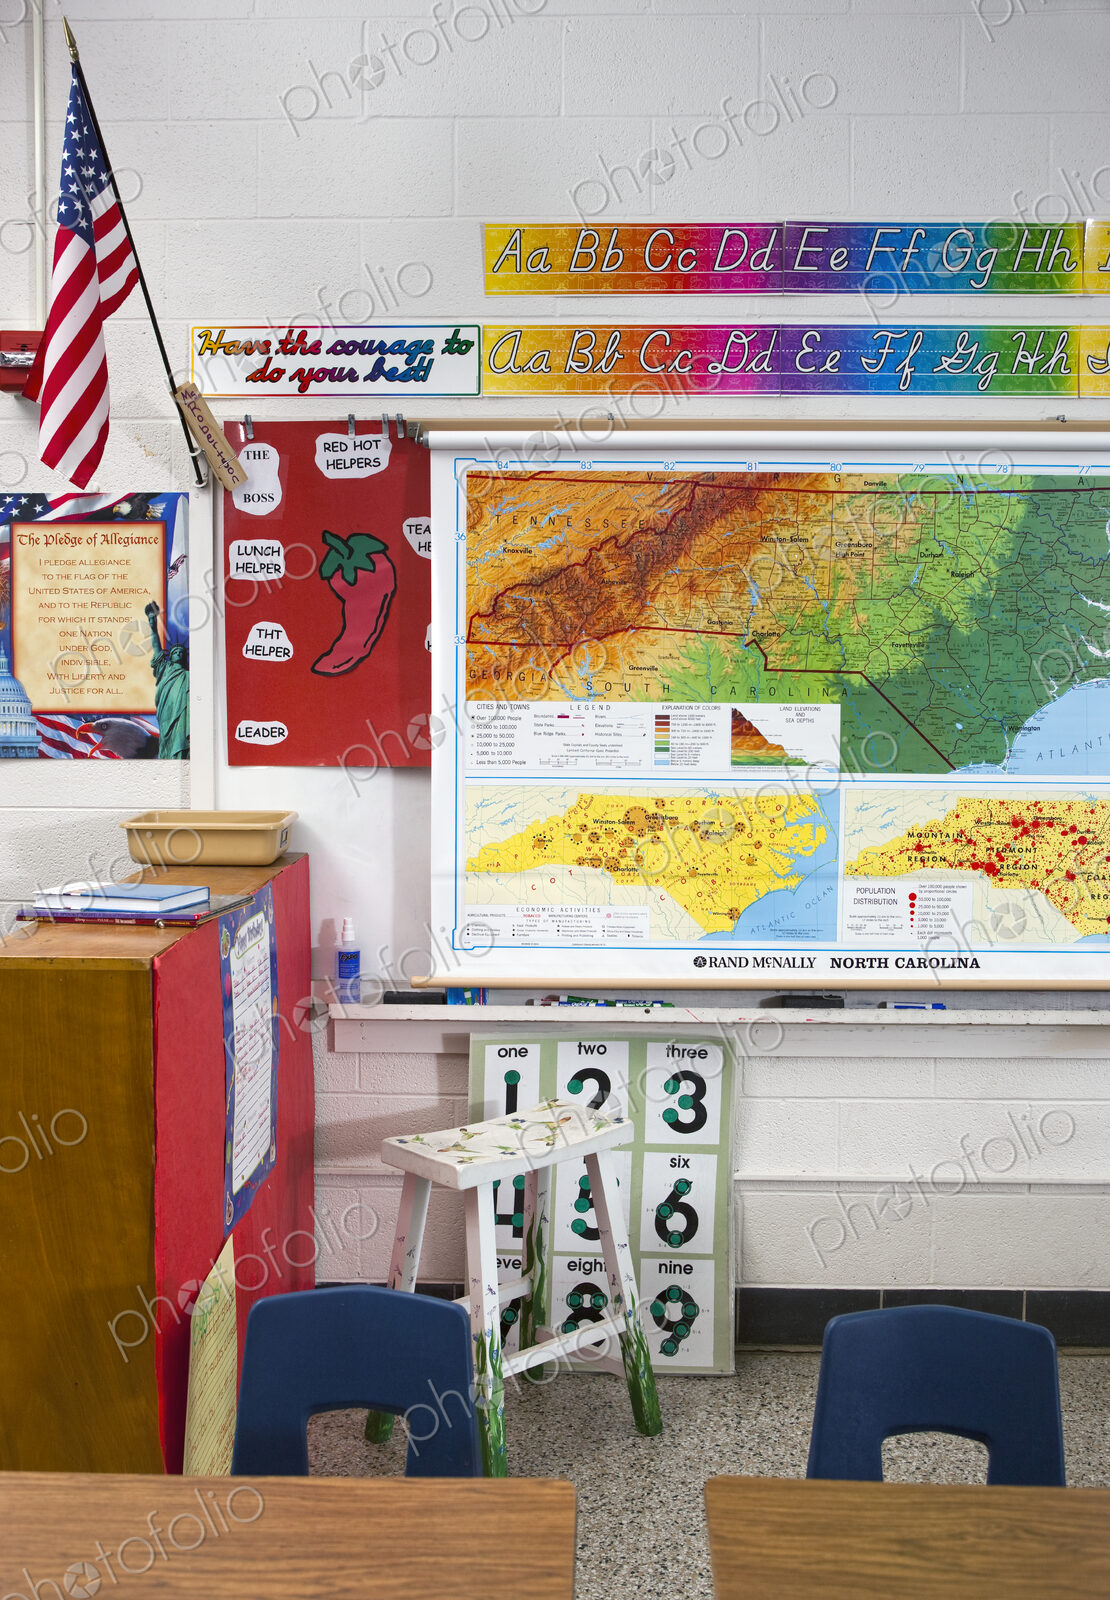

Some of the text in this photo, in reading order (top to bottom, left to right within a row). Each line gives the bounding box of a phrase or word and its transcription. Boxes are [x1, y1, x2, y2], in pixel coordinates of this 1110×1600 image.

[198, 328, 475, 366] Have the courage to
[246, 356, 435, 393] do your best!
[323, 439, 381, 453] RED HOT
[244, 450, 270, 460] THE
[326, 457, 381, 470] HELPERS
[497, 461, 509, 470] 84
[580, 461, 592, 470] 83
[664, 462, 676, 471] 82
[747, 462, 758, 471] 81
[830, 463, 842, 472] 80
[913, 464, 925, 472] 79
[997, 464, 1008, 473] 78
[1079, 466, 1091, 474] 77
[243, 493, 275, 503] BOSS
[495, 515, 645, 529] TENNESSEE
[16, 532, 160, 548] The Pledge of Allegiance
[455, 533, 466, 541] 36
[237, 545, 280, 557] LUNCH
[919, 551, 943, 559] Durham
[44, 558, 77, 566] PLEDGE
[78, 558, 131, 566] ALLEGIANCE
[236, 562, 282, 574] HELPER
[951, 571, 974, 580] Raleigh
[96, 587, 108, 595] OF
[38, 601, 57, 609] AND
[58, 601, 70, 609] TO
[72, 601, 88, 609] THE
[38, 616, 56, 624] FOR
[57, 616, 86, 624] WHICH
[88, 616, 96, 624] IT
[256, 628, 283, 640] THT
[752, 630, 780, 638] Charlotte
[454, 636, 466, 644] 35
[245, 644, 290, 658] HELPER
[469, 670, 546, 682] GEORGIA
[238, 727, 285, 738] LEADER
[856, 887, 896, 895] POPULATION
[709, 956, 749, 968] RAND
[830, 957, 981, 969] NORTH CAROLINA
[497, 1046, 528, 1058] one
[578, 1041, 607, 1055] two
[666, 1044, 709, 1060] three
[662, 1070, 708, 1134] 3
[669, 1155, 690, 1169] six
[655, 1177, 699, 1248] 6
[658, 1261, 693, 1275] nine
[650, 1285, 699, 1357] 9
